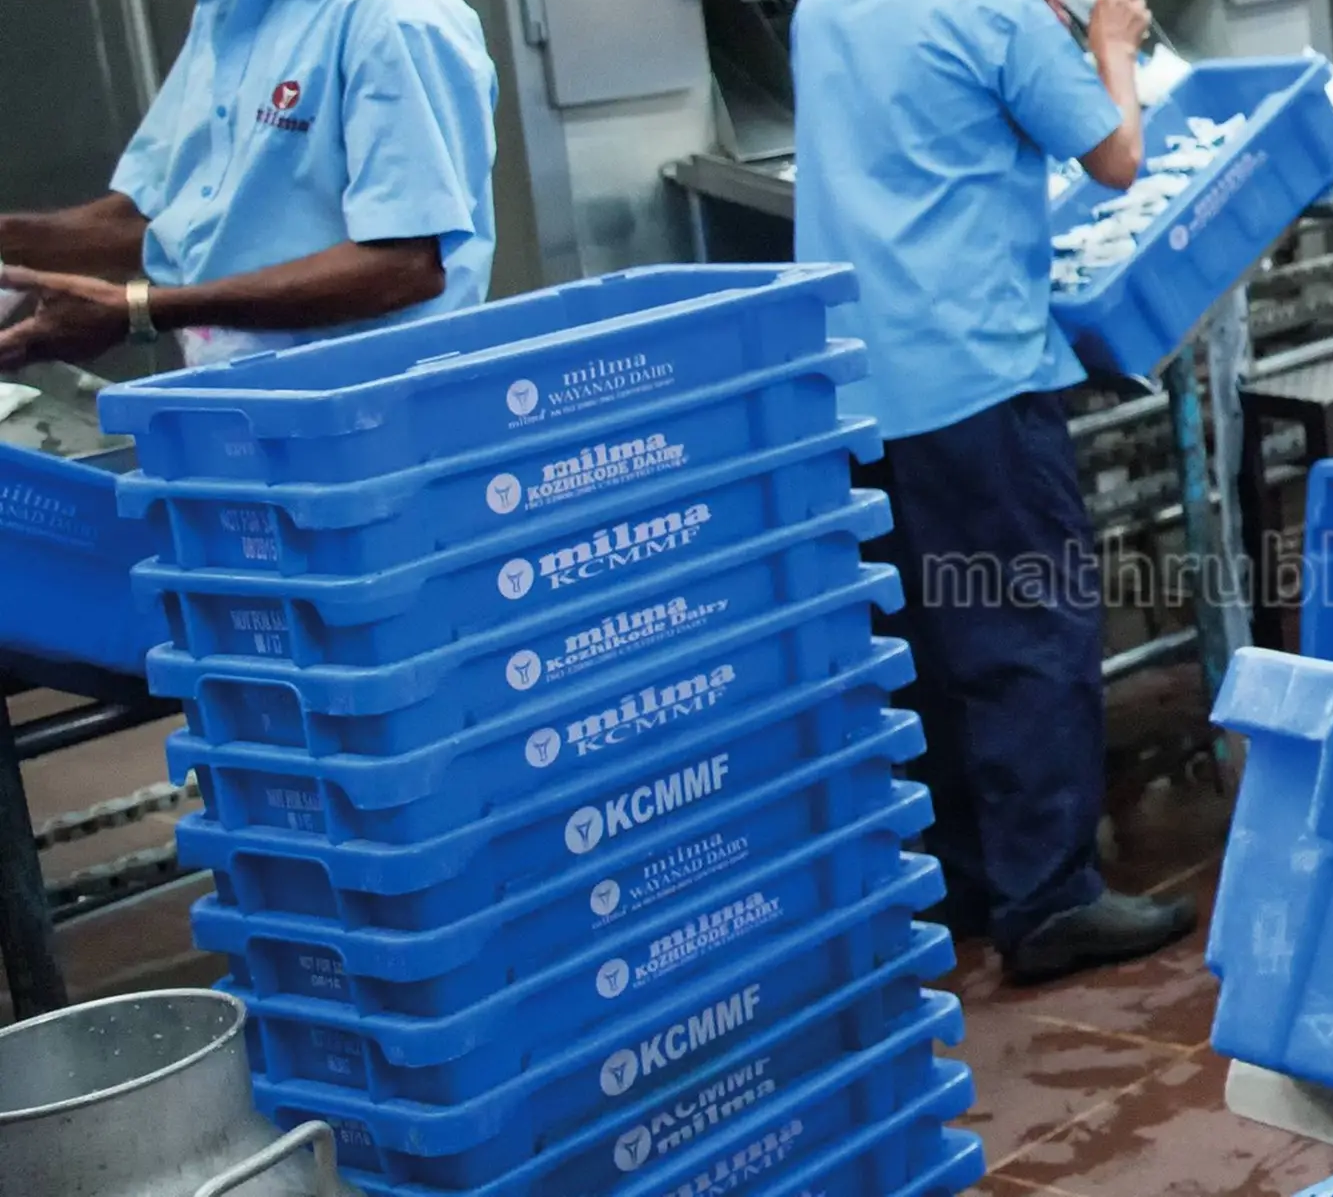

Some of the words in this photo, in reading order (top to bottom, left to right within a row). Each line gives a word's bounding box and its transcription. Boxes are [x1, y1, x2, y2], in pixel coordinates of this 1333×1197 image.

[548, 375, 625, 406] WAYANAD
[629, 362, 674, 383] DAIRY
[562, 353, 646, 386] milma
[526, 464, 629, 502] KOZHIKODE
[633, 444, 685, 471] DAIRY
[542, 433, 667, 482] milma
[538, 503, 712, 577] milma
[550, 525, 701, 590] KCMMF
[546, 621, 666, 674] Kozhikode
[671, 598, 729, 626] Dairy
[564, 596, 689, 654] milma
[566, 664, 736, 744] milma
[576, 685, 727, 757] KCMMF
[605, 753, 730, 838] KCMMF
[629, 858, 704, 900] WAYANAD
[706, 835, 750, 866] DAIRY
[643, 832, 724, 880] milma
[634, 924, 729, 980] KOZHIKODE
[732, 896, 780, 930] DAIRY
[649, 891, 765, 958] milma
[639, 983, 761, 1076] KCMMF
